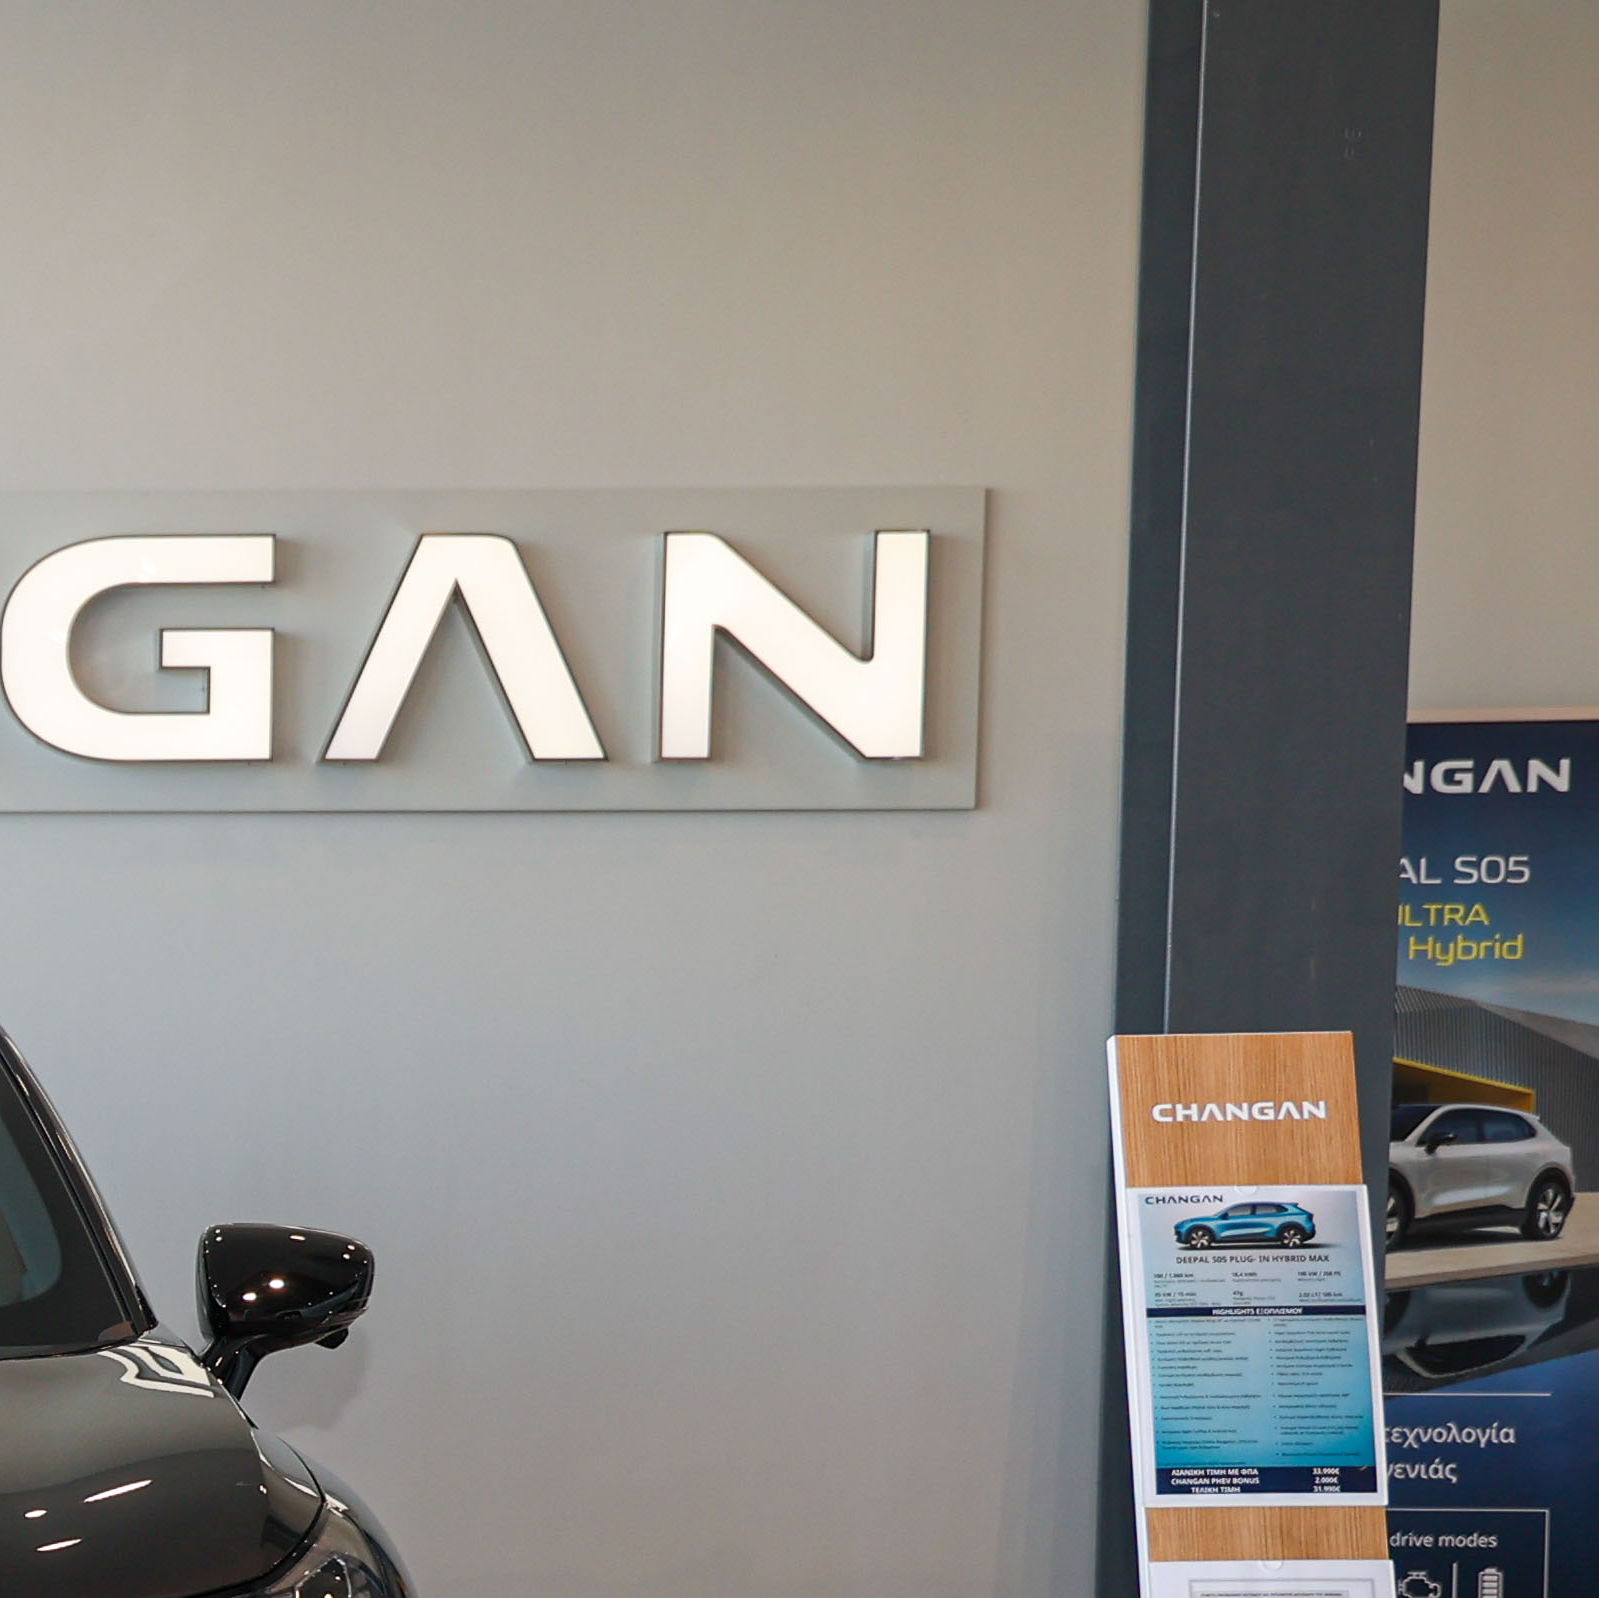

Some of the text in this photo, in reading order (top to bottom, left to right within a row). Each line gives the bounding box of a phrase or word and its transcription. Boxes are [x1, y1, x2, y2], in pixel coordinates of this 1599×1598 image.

[1454, 856, 1530, 884] S05
[1397, 903, 1490, 927] LTRA
[1408, 933, 1524, 967] Hybrid
[1151, 1100, 1328, 1124] CHANGAN
[1144, 1194, 1224, 1206] CHANGAN
[1176, 1256, 1210, 1265] DEEPAL
[1258, 1255, 1270, 1263] IN
[1271, 1255, 1307, 1263] HYBRID
[1308, 1254, 1330, 1263] MAX
[1227, 1468, 1239, 1476] ΜΕ
[1171, 1477, 1210, 1485] CHANGAN
[1211, 1477, 1231, 1485] PHEV
[1232, 1477, 1260, 1485] BONUS
[1219, 1486, 1241, 1494] ΤΙΜΗ
[1389, 1532, 1499, 1548] drive modes
